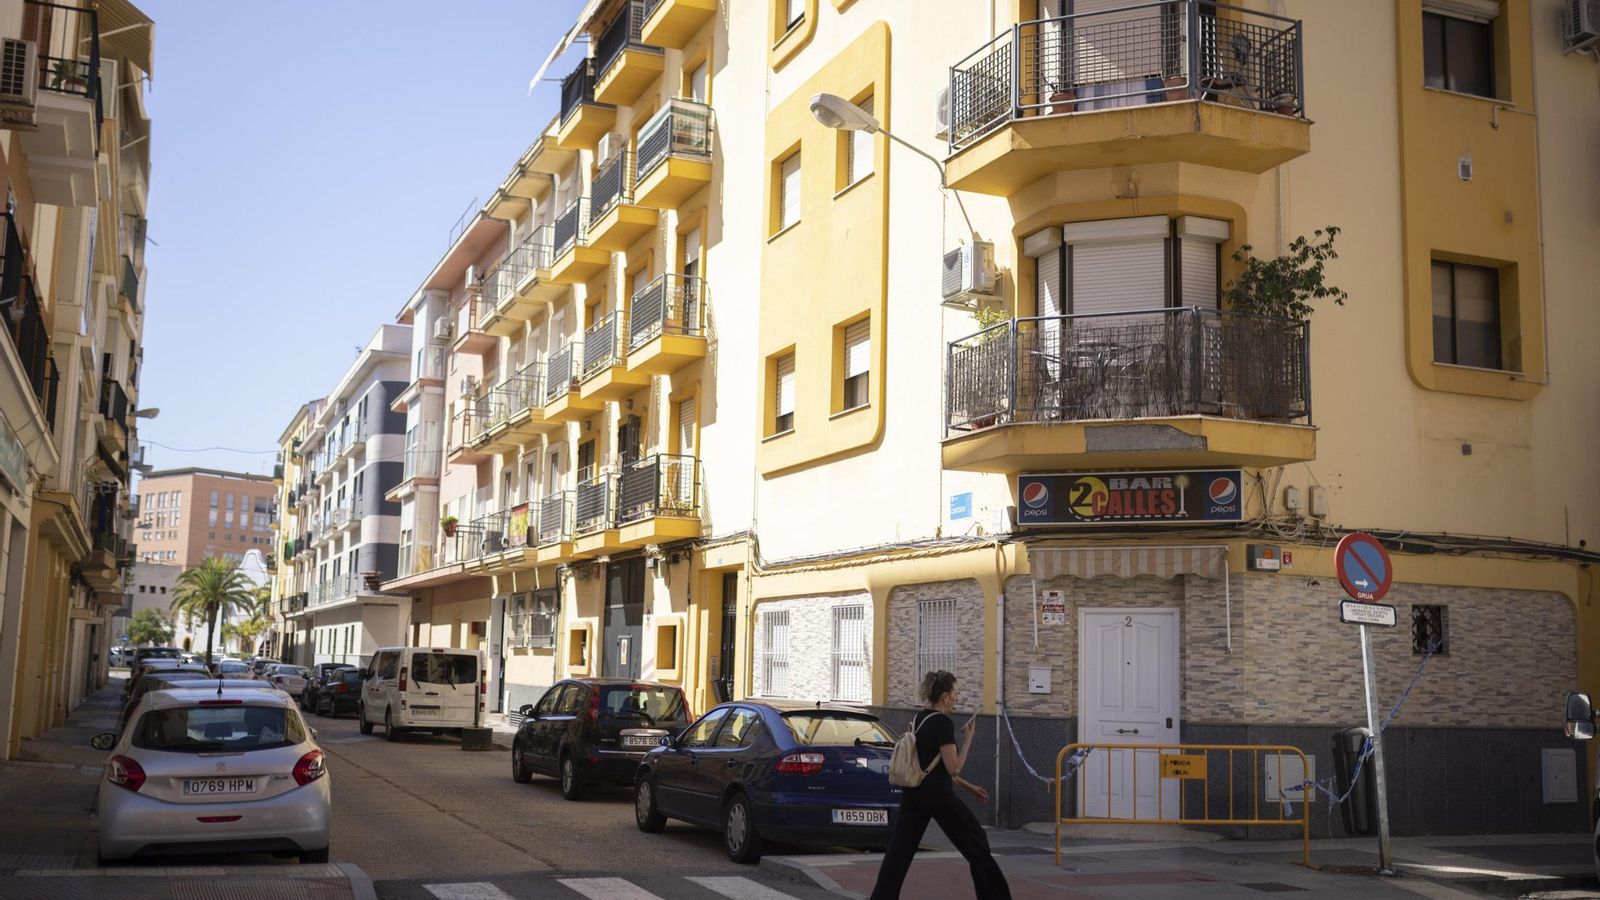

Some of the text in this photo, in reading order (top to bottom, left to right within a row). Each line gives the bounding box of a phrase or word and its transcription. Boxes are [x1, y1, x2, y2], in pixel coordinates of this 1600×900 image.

[1109, 477, 1172, 490] BAR
[1071, 482, 1176, 516] 2 CALLES
[1024, 509, 1048, 518] pepsi
[1210, 505, 1236, 514] pepsi
[1357, 592, 1374, 600] GRUA
[1125, 616, 1132, 627] 2
[629, 736, 647, 746] 8576
[191, 779, 254, 793] 0769 HPM
[840, 811, 885, 823] 1859 DBK
